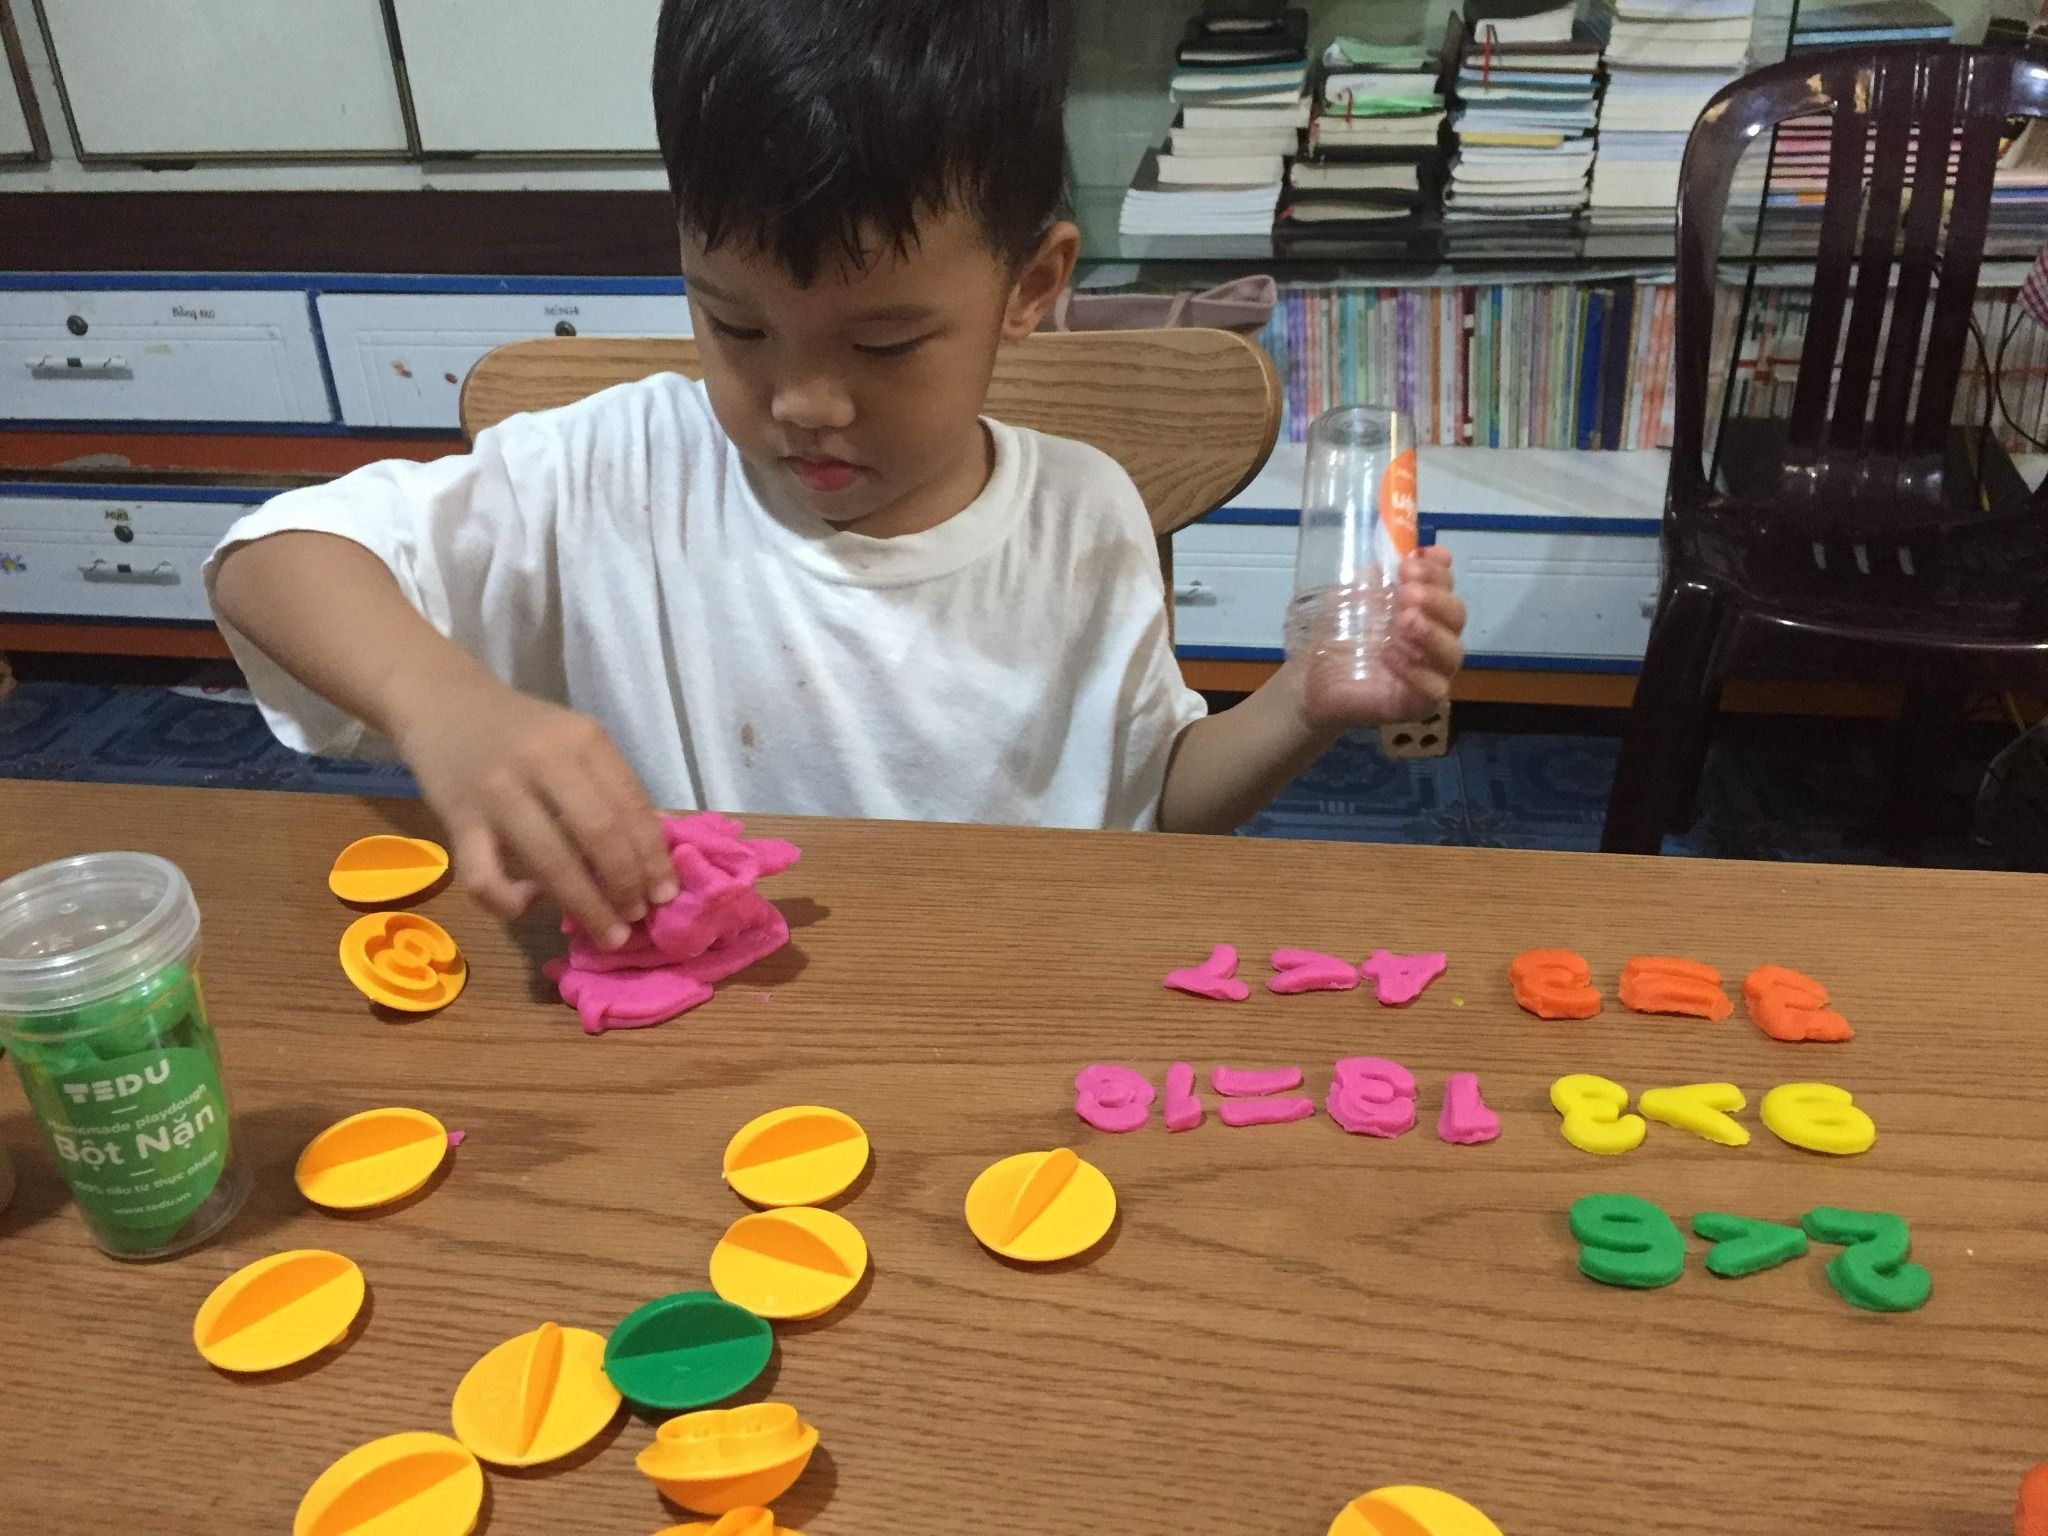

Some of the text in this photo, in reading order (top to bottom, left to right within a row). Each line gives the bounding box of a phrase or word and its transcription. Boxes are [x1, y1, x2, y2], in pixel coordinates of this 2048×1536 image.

[63, 1058, 171, 1104] TEDU
[136, 1083, 207, 1130] playdough
[53, 1105, 215, 1172] Bột Nặn
